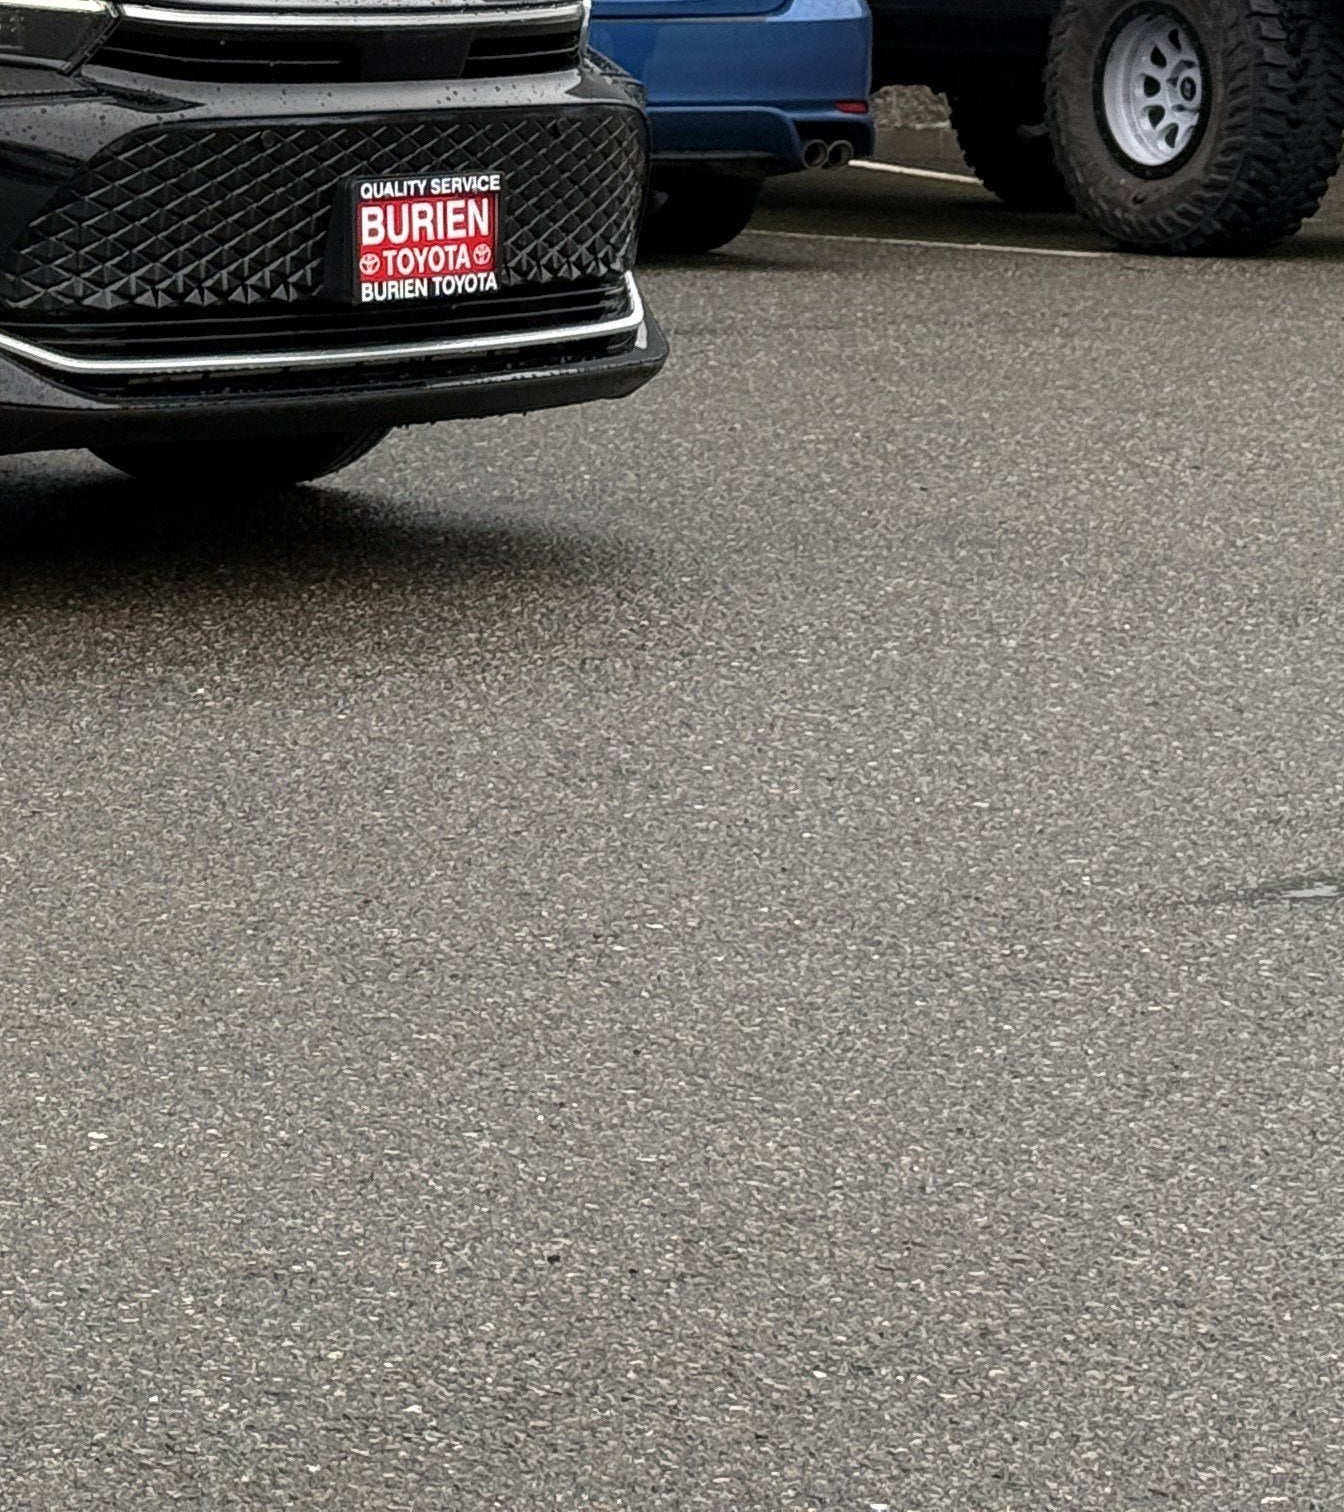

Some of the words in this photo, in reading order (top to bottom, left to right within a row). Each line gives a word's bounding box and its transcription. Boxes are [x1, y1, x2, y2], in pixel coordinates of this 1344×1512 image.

[360, 179, 427, 199] QUALITY
[430, 174, 501, 194] SERVICE
[361, 198, 490, 246] BURIEN
[382, 243, 472, 276] TOYOTA
[361, 277, 428, 302] BURIEN
[431, 271, 498, 296] TOYOTA
